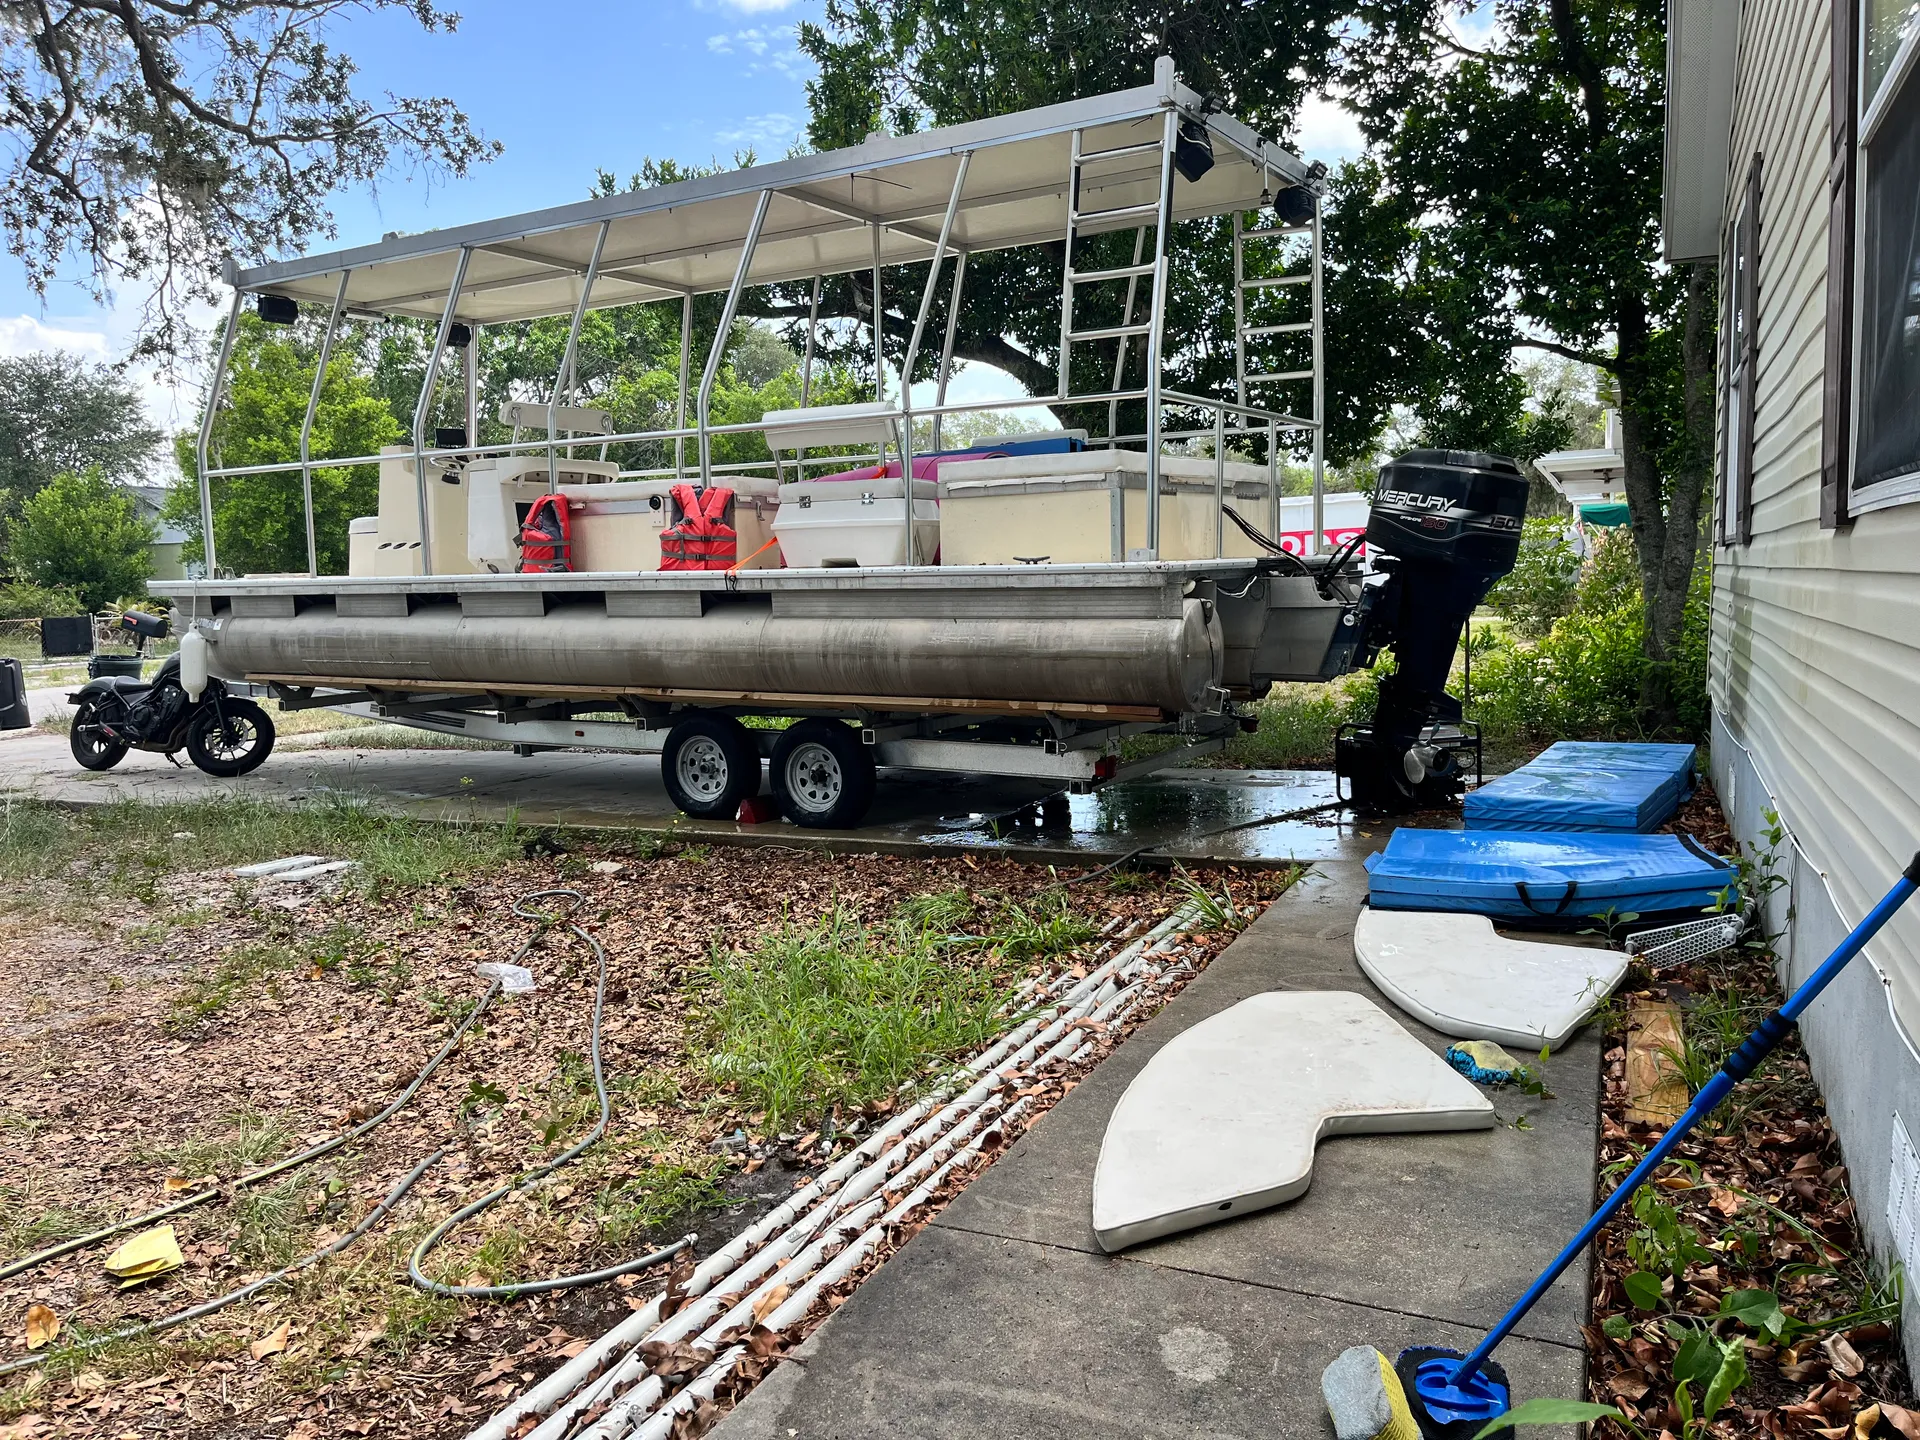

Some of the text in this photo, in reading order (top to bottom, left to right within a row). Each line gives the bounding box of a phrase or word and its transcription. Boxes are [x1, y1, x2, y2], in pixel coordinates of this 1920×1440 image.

[1377, 489, 1457, 511] MERCURY
[1420, 515, 1448, 530] 150
[1489, 515, 1516, 529] 150
